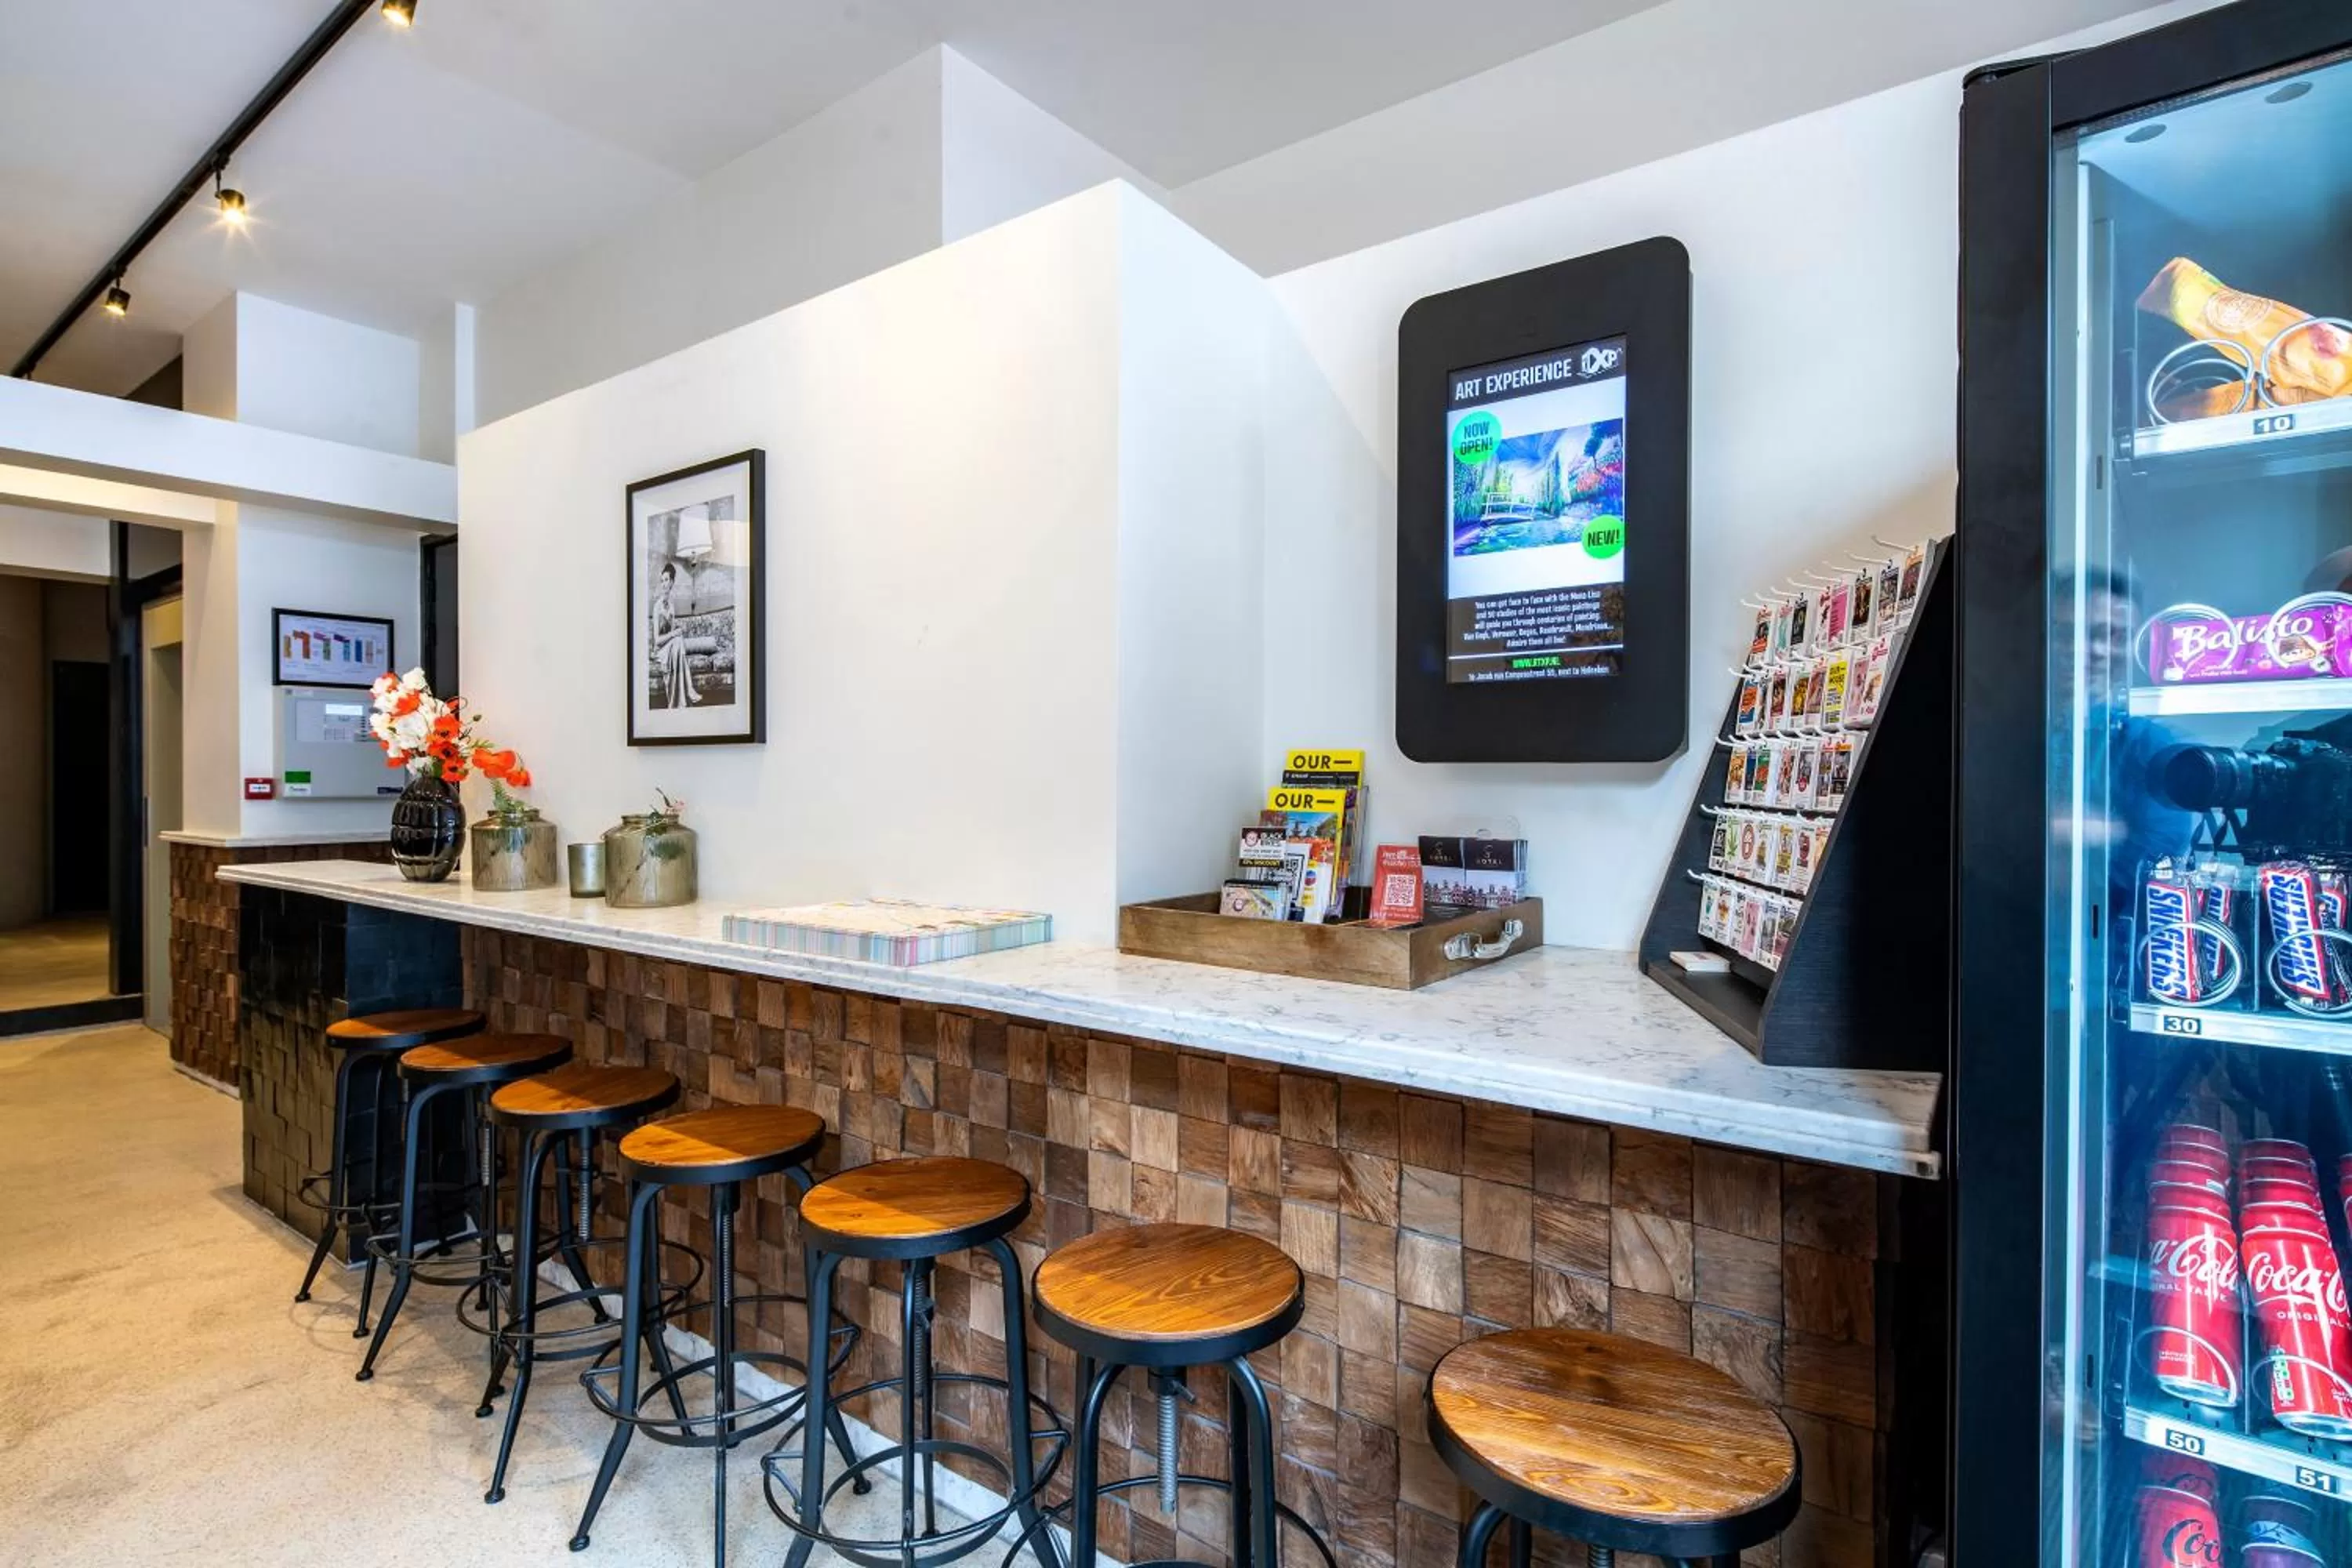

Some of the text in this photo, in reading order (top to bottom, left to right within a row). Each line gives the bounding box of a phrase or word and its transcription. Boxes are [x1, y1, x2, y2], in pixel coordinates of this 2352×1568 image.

[1455, 379, 1482, 401] ART
[1486, 358, 1572, 394] EXPERIENCE
[1464, 422, 1490, 439] NOW
[2258, 417, 2290, 432] 10
[1460, 437, 1493, 456] OPEN!
[1588, 529, 1620, 547] NEW!
[2270, 873, 2321, 991] SNICKERS
[2149, 887, 2189, 999] SNICKERS
[2166, 1018, 2199, 1033] 30
[2277, 1310, 2345, 1328] ORIGIAL
[2169, 1432, 2201, 1454] 50
[2299, 1468, 2331, 1491] 51
